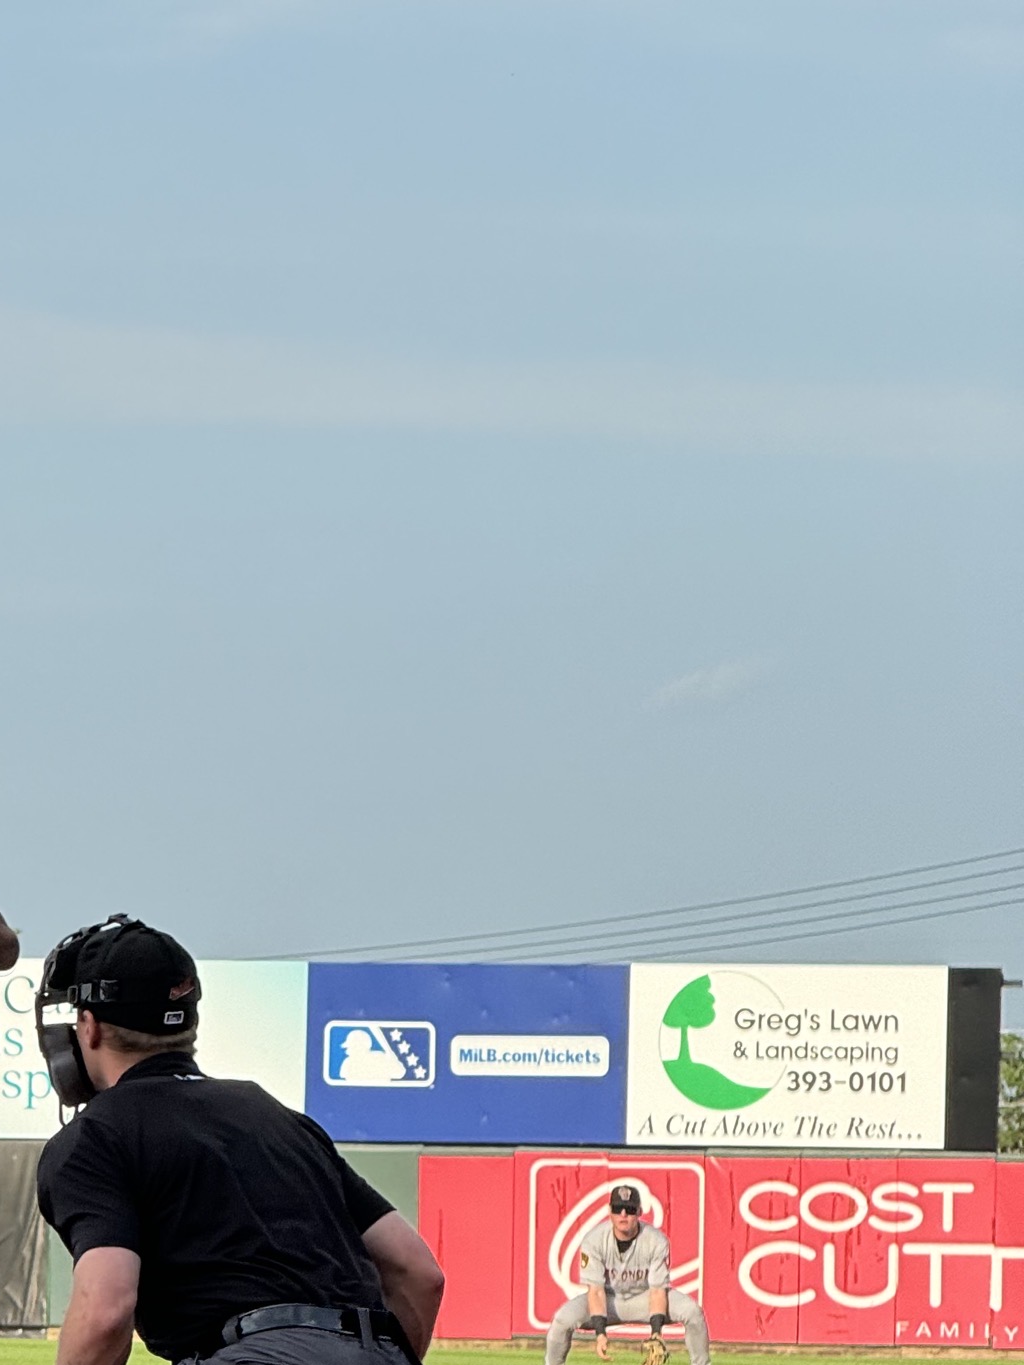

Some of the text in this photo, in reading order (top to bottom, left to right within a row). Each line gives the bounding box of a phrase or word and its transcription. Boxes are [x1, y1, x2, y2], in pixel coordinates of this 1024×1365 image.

[734, 1008, 899, 1036] Greg's Lawn
[459, 1048, 601, 1066] MiLB.com/tickets
[733, 1041, 899, 1065] & Landscaping
[787, 1071, 907, 1093] 393-0101
[637, 1113, 922, 1139] A Cut Above The Rest...
[739, 1181, 974, 1232] COST
[738, 1241, 1024, 1312] CUTT
[896, 1321, 1018, 1343] FAMILY
